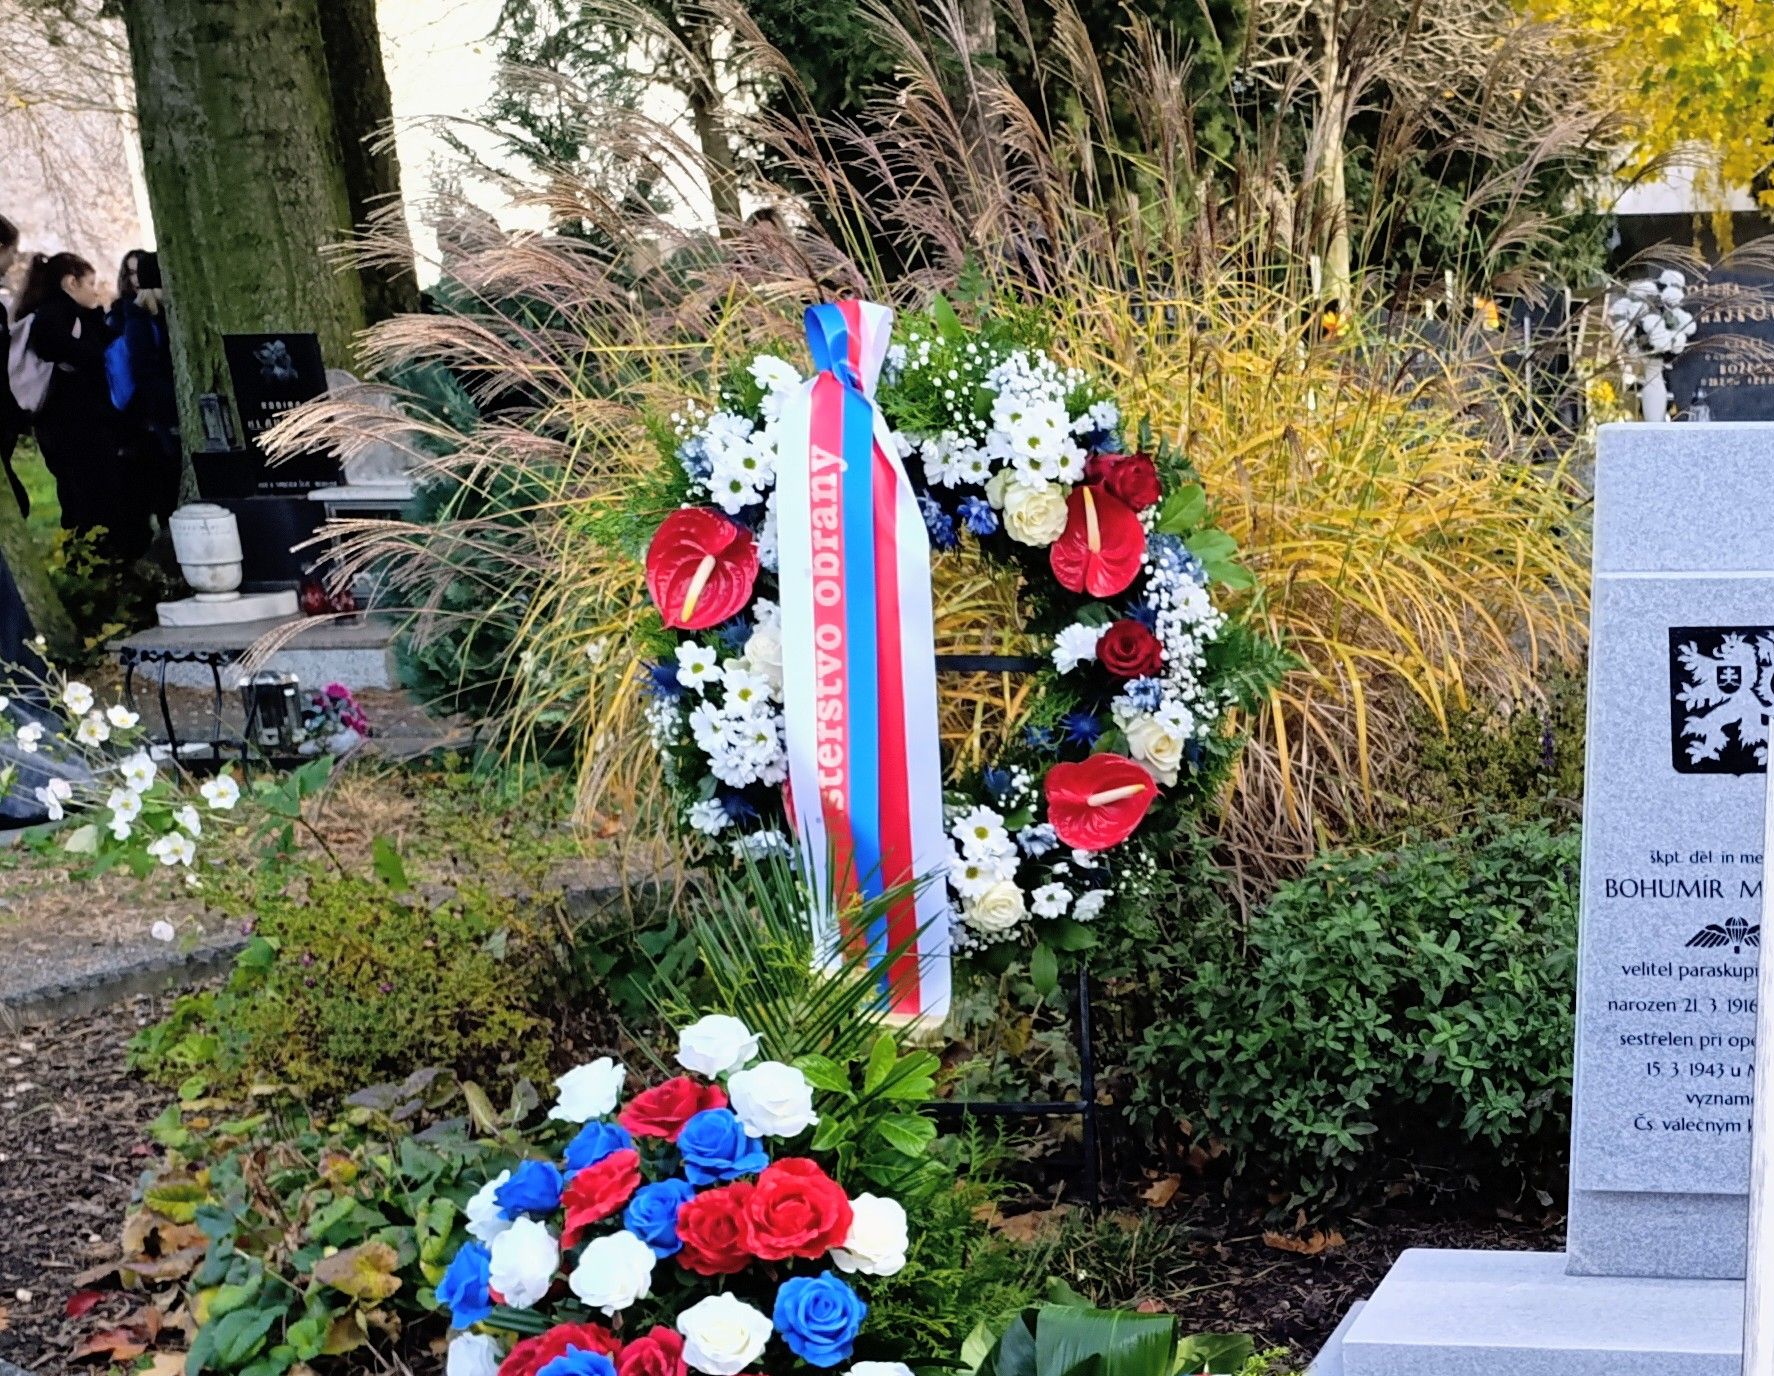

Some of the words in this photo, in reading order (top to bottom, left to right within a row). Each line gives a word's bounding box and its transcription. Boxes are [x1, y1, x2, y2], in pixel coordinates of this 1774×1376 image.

[810, 443, 848, 608] obrany
[1721, 852, 1734, 864] in
[1605, 874, 1725, 899] BOHUMÍR
[1621, 961, 1672, 978] velitel
[1608, 998, 1677, 1013] narozen
[1620, 1031, 1694, 1047] sestřelen
[1699, 1034, 1722, 1051] při
[1689, 1062, 1725, 1079] 1943
[1730, 1067, 1741, 1077] u
[1662, 1117, 1741, 1136] válečným
